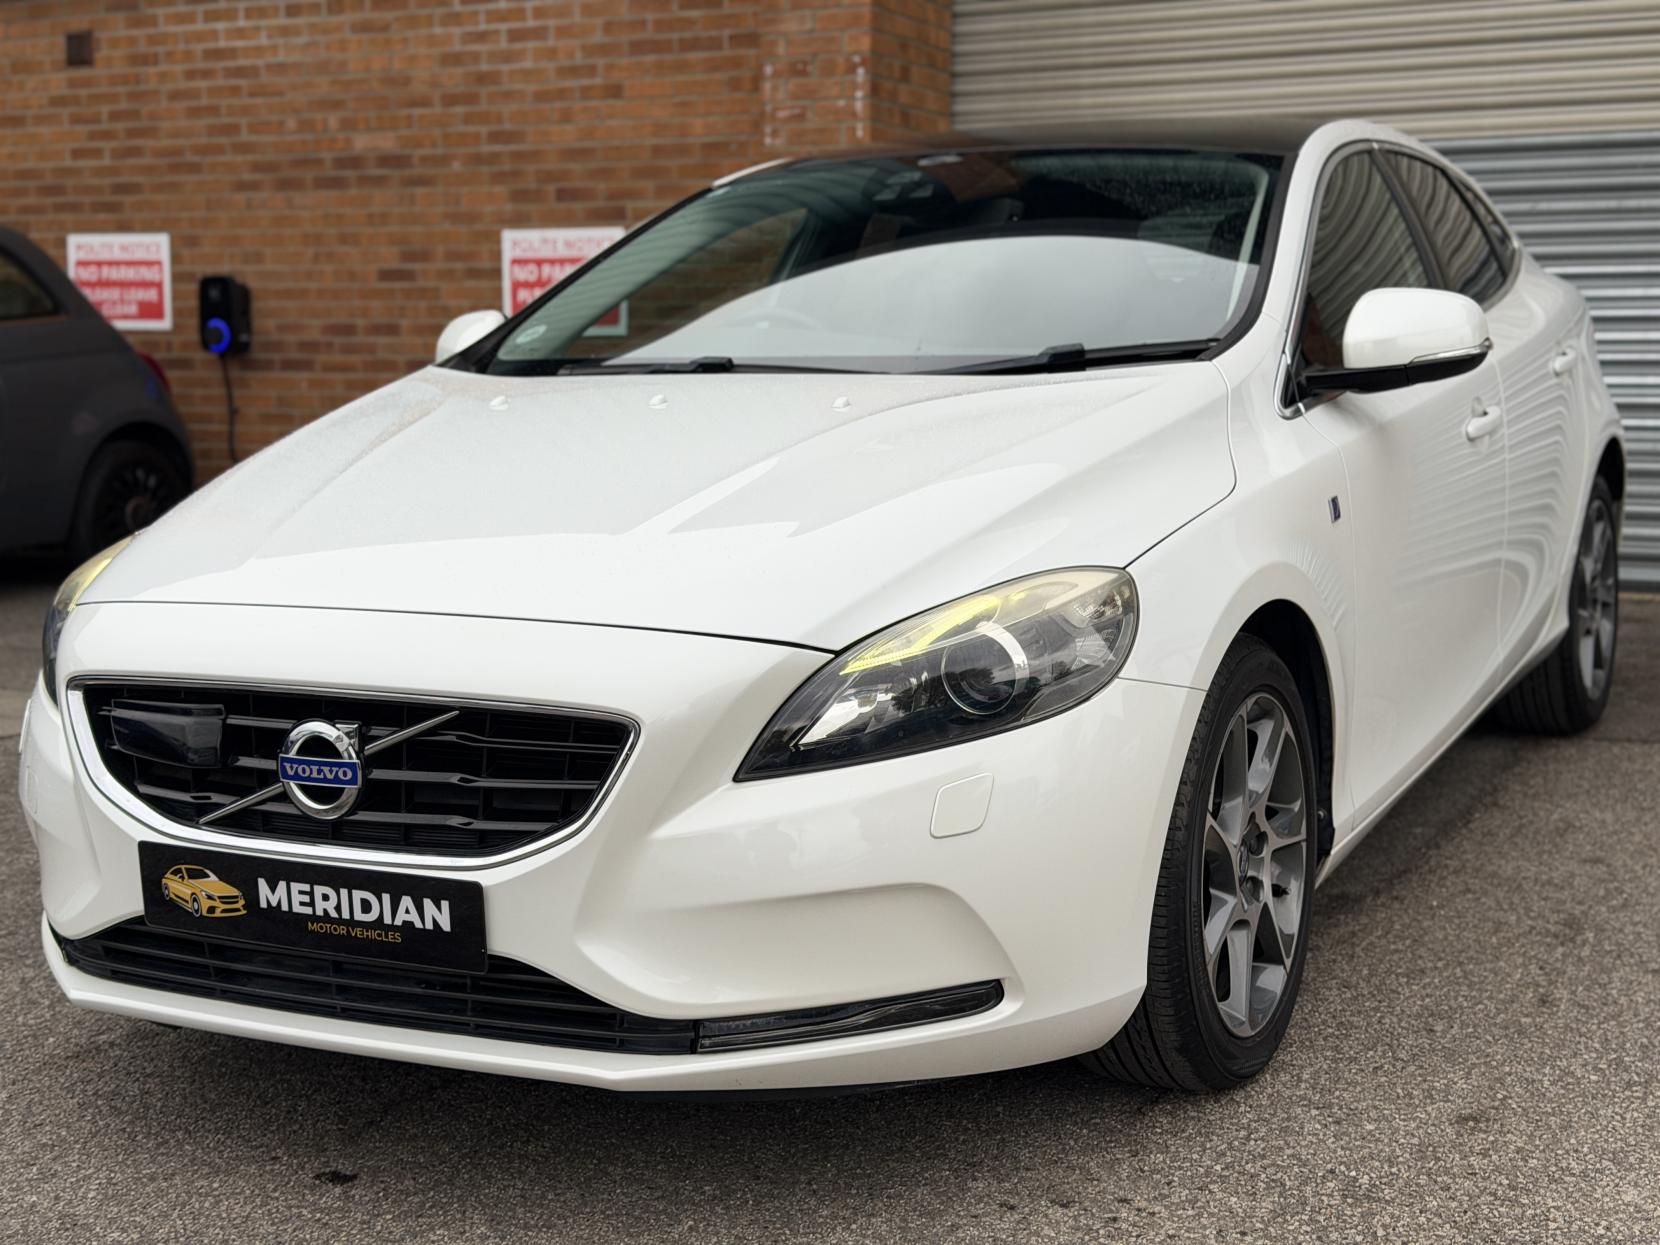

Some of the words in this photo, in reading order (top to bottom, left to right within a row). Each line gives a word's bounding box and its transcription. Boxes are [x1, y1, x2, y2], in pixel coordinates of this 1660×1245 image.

[77, 263, 98, 282] NO
[101, 263, 162, 282] PARKING
[511, 262, 539, 282] NO
[283, 762, 352, 780] VOLVO
[257, 877, 451, 933] MERIDIAN
[308, 921, 348, 936] MOTOR
[349, 926, 402, 944] VEHICLES
